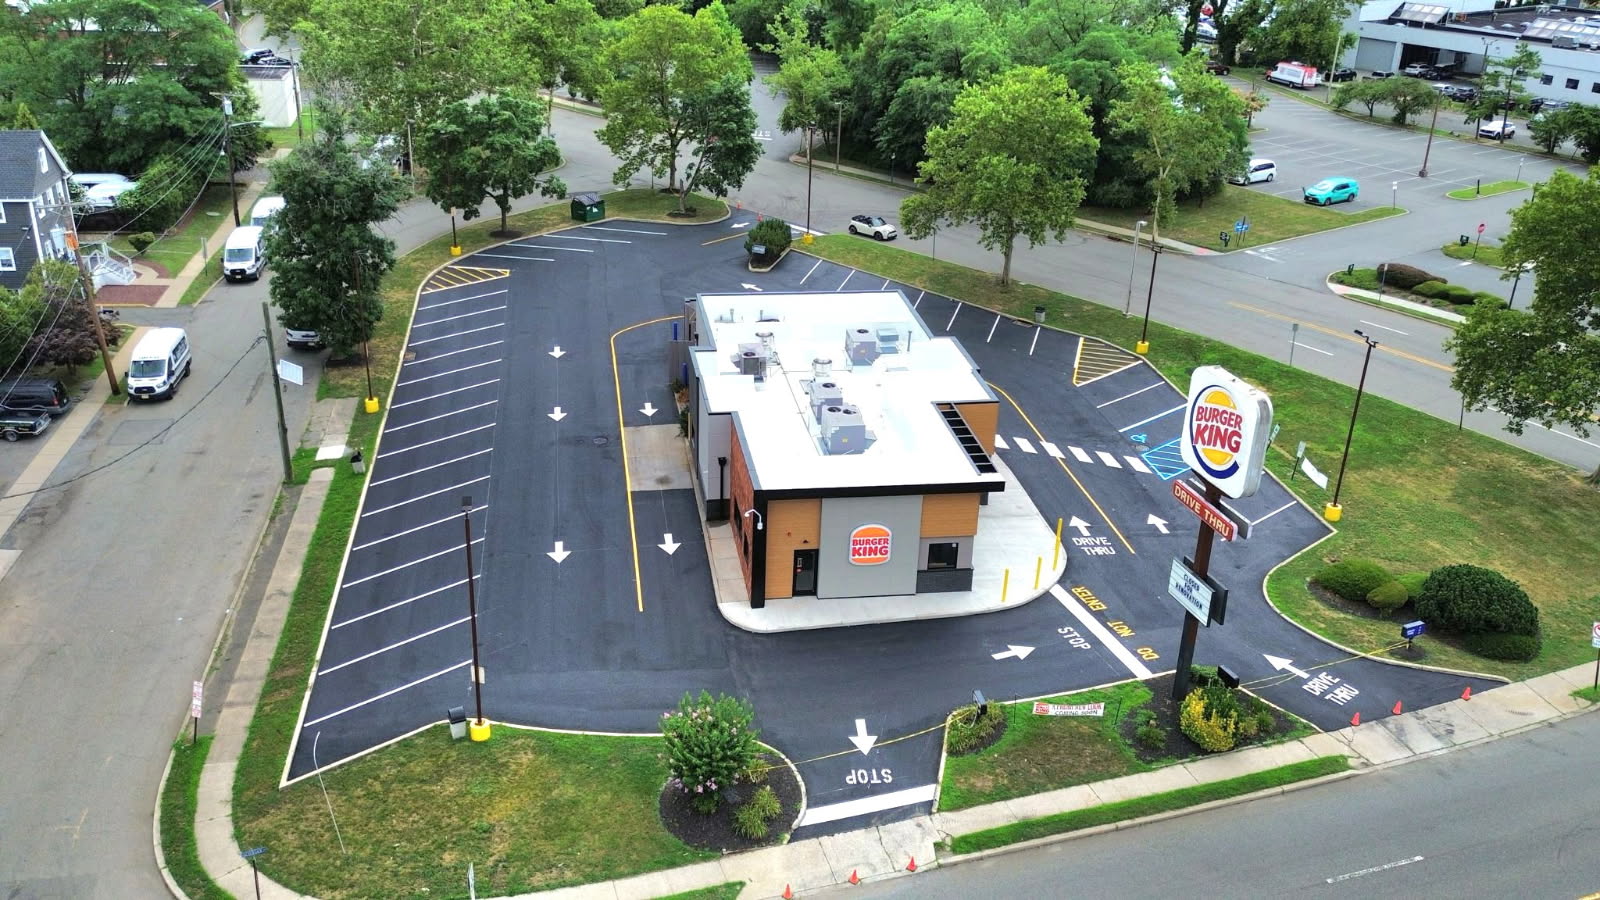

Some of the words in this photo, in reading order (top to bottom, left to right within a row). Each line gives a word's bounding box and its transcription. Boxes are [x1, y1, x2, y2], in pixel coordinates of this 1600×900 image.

[1195, 405, 1243, 431] BURGER
[1193, 423, 1243, 454] KING
[1174, 485, 1201, 514] DRIVE
[1204, 509, 1230, 537] THRU
[852, 537, 889, 546] BURGER
[1072, 537, 1112, 546] DRIVE
[1081, 546, 1116, 555] THRU
[851, 546, 889, 557] KING
[1183, 573, 1200, 591] CLOSED
[1184, 582, 1193, 593] FOR
[1071, 586, 1107, 611] ENTER
[1175, 582, 1203, 610] RENOVATION
[1057, 626, 1092, 650] STOP
[1107, 621, 1136, 637] NOT
[1136, 647, 1160, 660] DO
[1301, 671, 1341, 696] DRIVE
[1324, 683, 1360, 706] THRU
[845, 768, 893, 785] STOP
